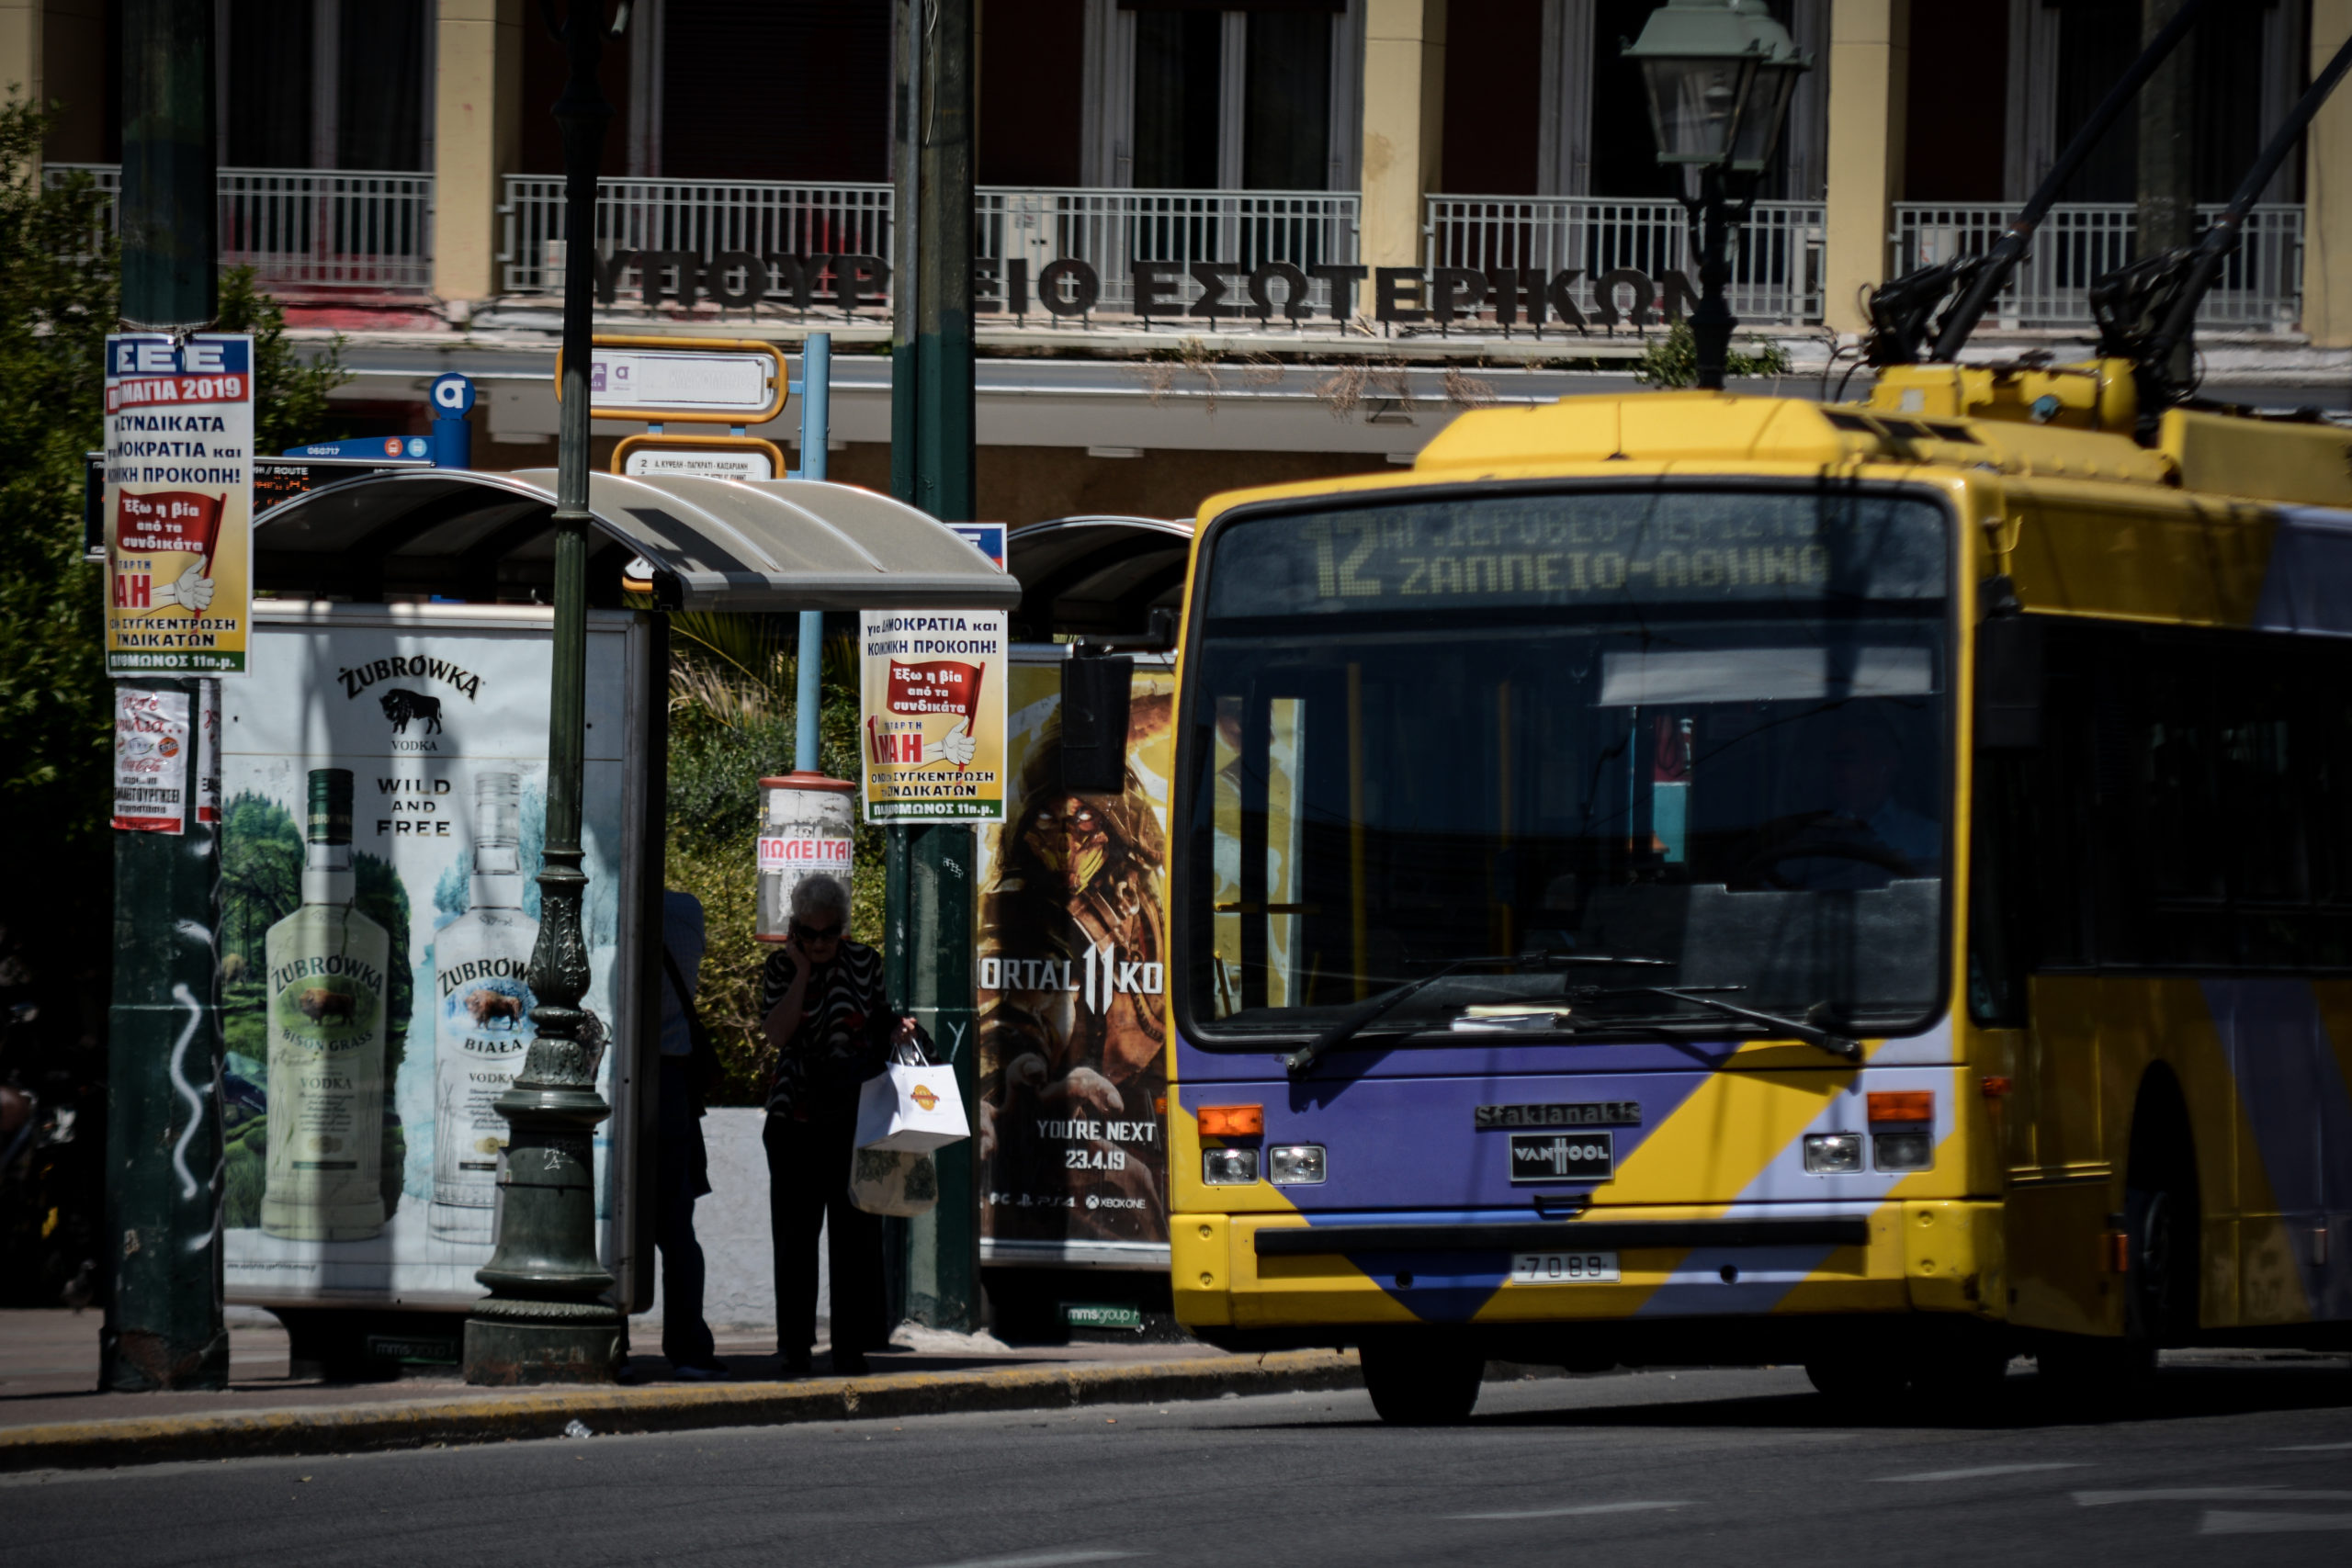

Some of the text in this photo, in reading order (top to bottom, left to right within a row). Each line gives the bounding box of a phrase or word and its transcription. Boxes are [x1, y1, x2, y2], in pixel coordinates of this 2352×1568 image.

[593, 249, 1099, 317] ΥΠΟΥΡΕΙΟ
[182, 378, 242, 400] 2019
[213, 448, 241, 457] και
[143, 467, 240, 483] ΠΡΟΚΟΠΗ!
[155, 503, 167, 518] η
[171, 502, 199, 519] βία
[136, 519, 183, 534] από τα
[122, 535, 204, 552] συνδικάτα
[1300, 512, 1381, 596] 12
[973, 623, 998, 632] και
[914, 640, 997, 654] ΠΡΟΚΟΠΗ!
[337, 655, 481, 705] ŻUBRÓWKA
[893, 668, 963, 685] Έξω η βία
[907, 686, 948, 698] από τα
[893, 700, 967, 714] συνδικάτα
[391, 740, 438, 751] VODKA
[894, 772, 994, 783] ΣΥΓΚΕΝΤΡΩΣΗ
[378, 779, 451, 795] WILD
[391, 801, 436, 813] AND
[377, 819, 451, 837] FREE
[760, 840, 851, 861] ΠΩΛΕΙΤΑΙ
[270, 955, 383, 995] ŻUBRÓWKA
[437, 958, 531, 998] ŻUBRÓW
[978, 957, 1080, 991] ORTAL
[1119, 961, 1164, 995] KO
[282, 1029, 373, 1052] BISON GRASS
[464, 1038, 523, 1054] BIAŁA
[300, 1077, 353, 1090] VODKA
[1036, 1118, 1157, 1143] YOU'RE NEXT
[1065, 1149, 1125, 1171] 23.4.19
